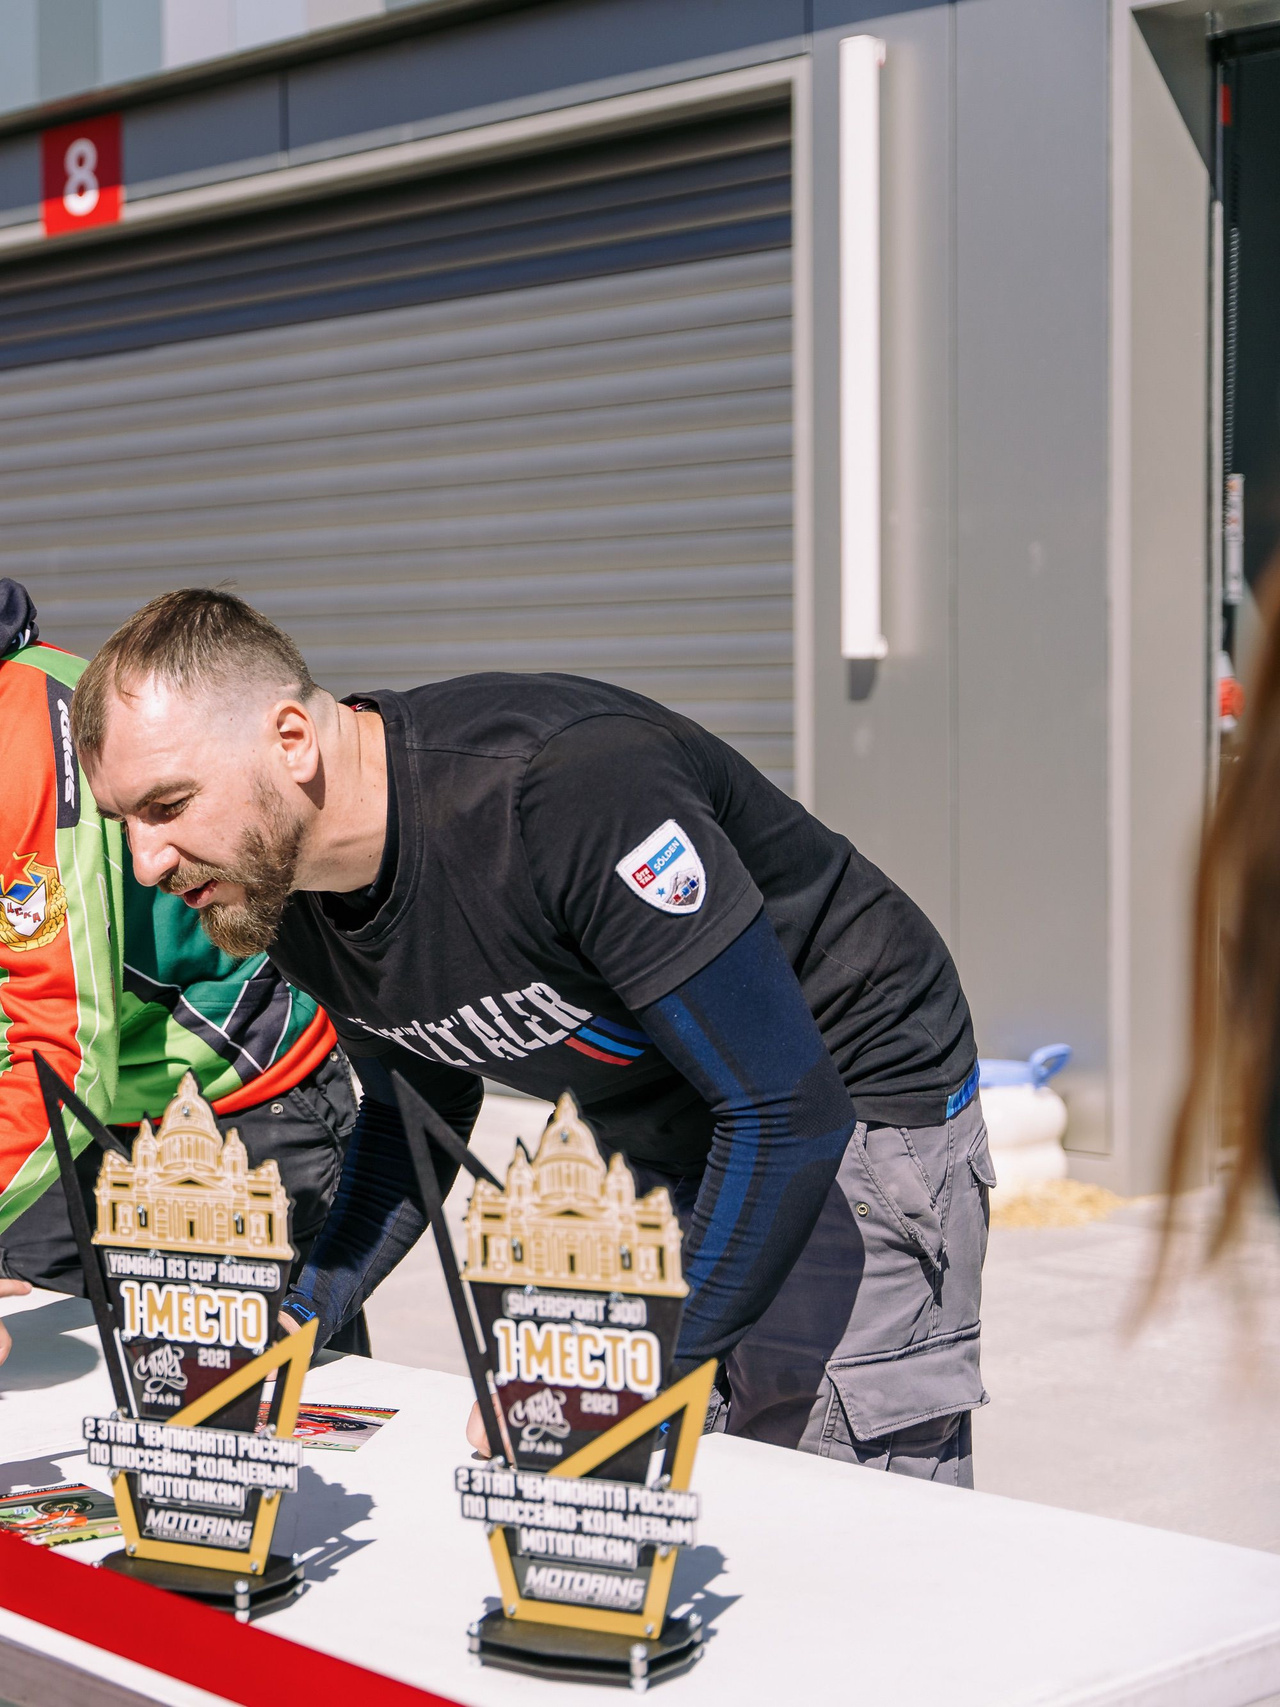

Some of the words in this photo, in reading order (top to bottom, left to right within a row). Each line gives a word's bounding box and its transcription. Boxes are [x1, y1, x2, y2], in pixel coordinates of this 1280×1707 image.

[63, 138, 100, 216] 8
[57, 698, 75, 809] SPIDI
[654, 840, 680, 871] SÖLDEN
[640, 875, 654, 885] TAL
[7, 902, 41, 923] ЦСКА
[109, 1254, 164, 1277] YAMAHA
[167, 1258, 186, 1279] R3
[188, 1260, 216, 1281] CUP
[218, 1263, 277, 1287] ROOKIES
[144, 1284, 266, 1346] МЕСТО
[508, 1292, 606, 1322] SUPERSPORT
[609, 1300, 642, 1325] 300
[198, 1347, 230, 1369] 2021
[521, 1322, 658, 1391] МЕСТО
[142, 1392, 181, 1406] ДРАЙВ
[580, 1392, 618, 1416] 2021
[85, 1419, 96, 1439] 2
[97, 1420, 137, 1444] ЭТАП
[138, 1425, 237, 1458] ЧЕМПИОНАТА
[238, 1437, 299, 1464] РОССИИ
[90, 1441, 110, 1465] ПО
[111, 1444, 295, 1488] ШОССЕЙНО-КОЛЬЦЕВЫМ
[141, 1472, 241, 1506] МОТОГОНКАМ
[456, 1471, 469, 1492] 2
[470, 1471, 515, 1497] ЭТАП
[516, 1475, 627, 1512] ЧЕМПИОНАТА
[628, 1488, 697, 1518] РОССИИ
[146, 1508, 253, 1540] MOTORING
[463, 1494, 486, 1518] ПО
[487, 1496, 693, 1545] ШОССЕЙНО-КОЛЬЦЕВЫМ
[521, 1528, 633, 1564] МОТОГОНКАМ
[525, 1565, 646, 1600] MOTORING
